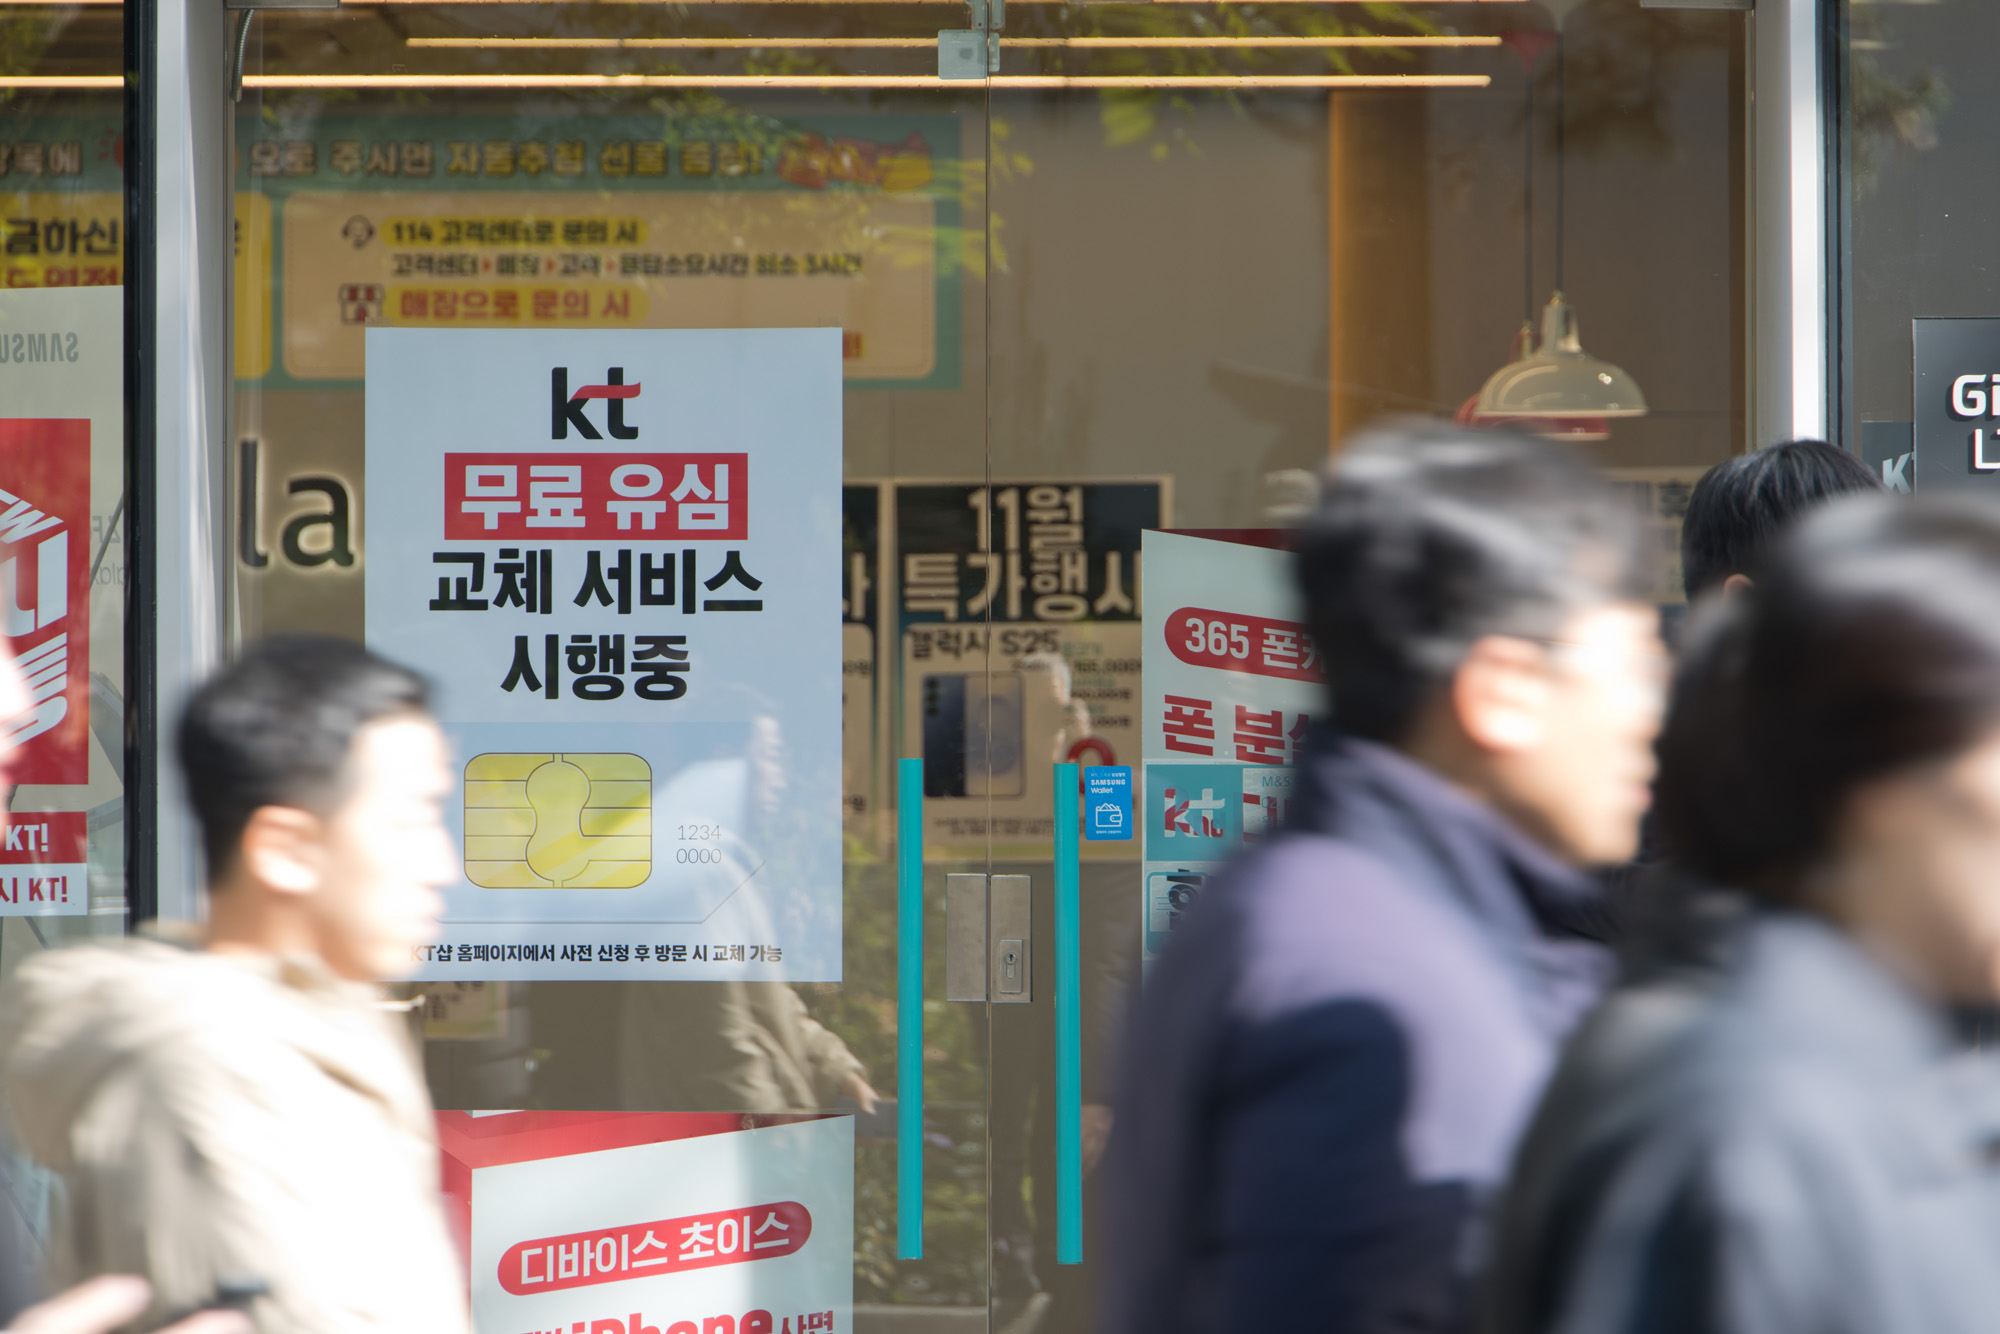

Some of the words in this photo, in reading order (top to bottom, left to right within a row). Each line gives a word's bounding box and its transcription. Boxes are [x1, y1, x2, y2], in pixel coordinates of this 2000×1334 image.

[0, 216, 119, 256] 금하신
[393, 221, 433, 241] 114
[617, 221, 638, 242] 시
[602, 290, 630, 319] 시
[551, 366, 641, 440] kt
[461, 464, 586, 530] 무료
[606, 463, 729, 530] 유심
[967, 485, 1084, 552] 11월
[429, 548, 552, 615] 교체
[573, 548, 763, 615] 서비스
[1000, 629, 1060, 655] S25
[1185, 616, 1249, 659] 365
[500, 634, 690, 700] 시행중
[1163, 693, 1215, 757] 폰
[677, 824, 722, 841] 1234
[1164, 787, 1225, 838] kt
[676, 848, 722, 865] 0000
[29, 876, 67, 903] KT!
[411, 944, 453, 962] KT샵
[457, 944, 555, 962] 홈페이지에서
[560, 944, 593, 962] 사전
[597, 944, 630, 962] 신청
[634, 944, 650, 962] 후
[654, 944, 687, 962] 방문
[692, 944, 708, 962] 시
[712, 944, 745, 962] 교체
[750, 944, 783, 962] 가능
[521, 1229, 668, 1285] 디바이스
[679, 1211, 790, 1261] 초이스
